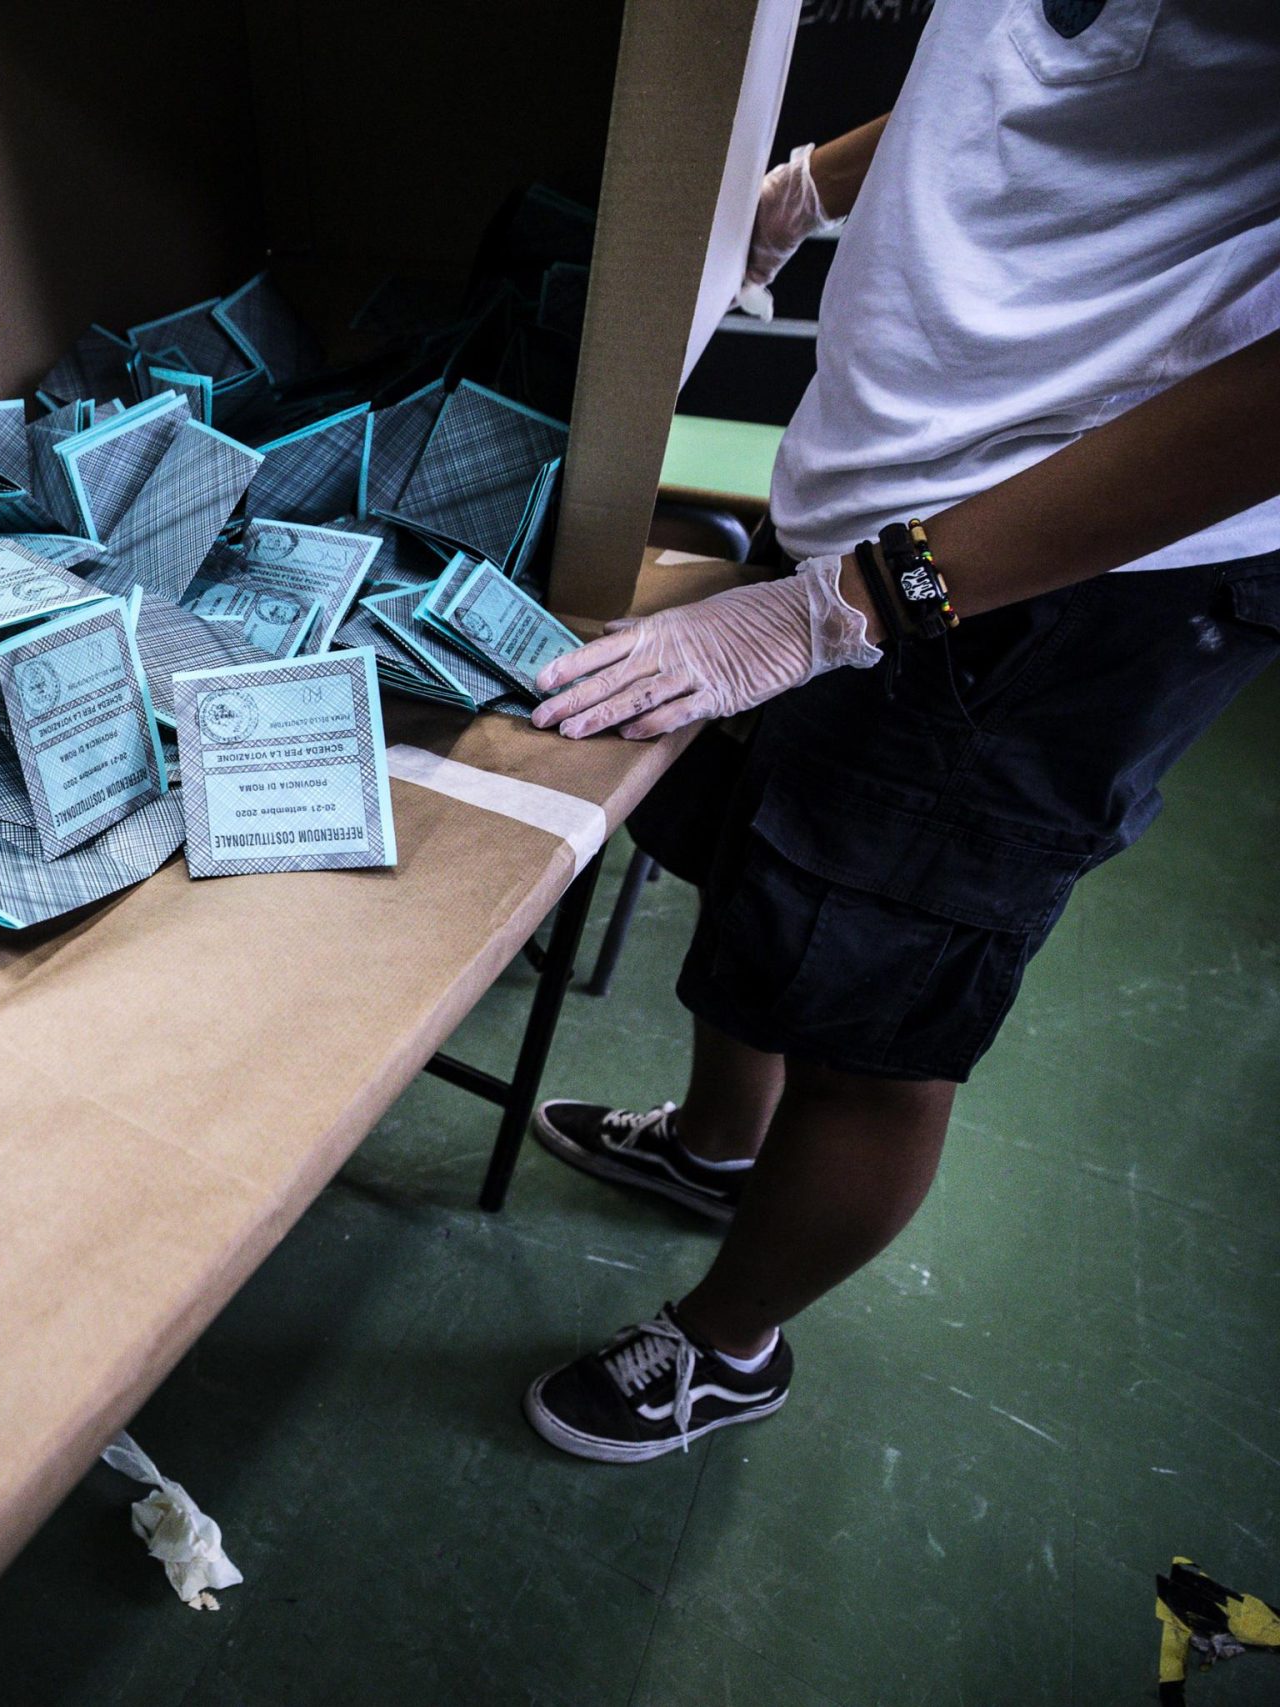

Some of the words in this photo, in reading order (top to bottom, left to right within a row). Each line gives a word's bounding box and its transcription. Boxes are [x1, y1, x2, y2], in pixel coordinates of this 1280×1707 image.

[96, 692, 122, 710] SCHEDA
[82, 704, 96, 716] PER
[72, 711, 81, 721] LA
[38, 715, 72, 737] VOTAZIONE
[85, 728, 118, 751] PROVINCIA
[77, 745, 84, 754] DI
[269, 749, 280, 757] LA
[284, 747, 302, 756] PER
[305, 743, 343, 754] SCHEDA
[59, 749, 77, 763] ROMA
[216, 751, 266, 762] VOTAZIONE
[105, 765, 147, 799] REFERENDUM
[238, 783, 264, 792] ROMA
[279, 778, 327, 789] PROVINCIA
[54, 788, 105, 827] COSTITUZIONALE
[260, 805, 307, 815] settembre
[310, 803, 335, 811] 20-21
[235, 809, 257, 817] 2020
[214, 831, 294, 847] COSTITUZIONALE
[298, 827, 363, 842] REFERENDUM
